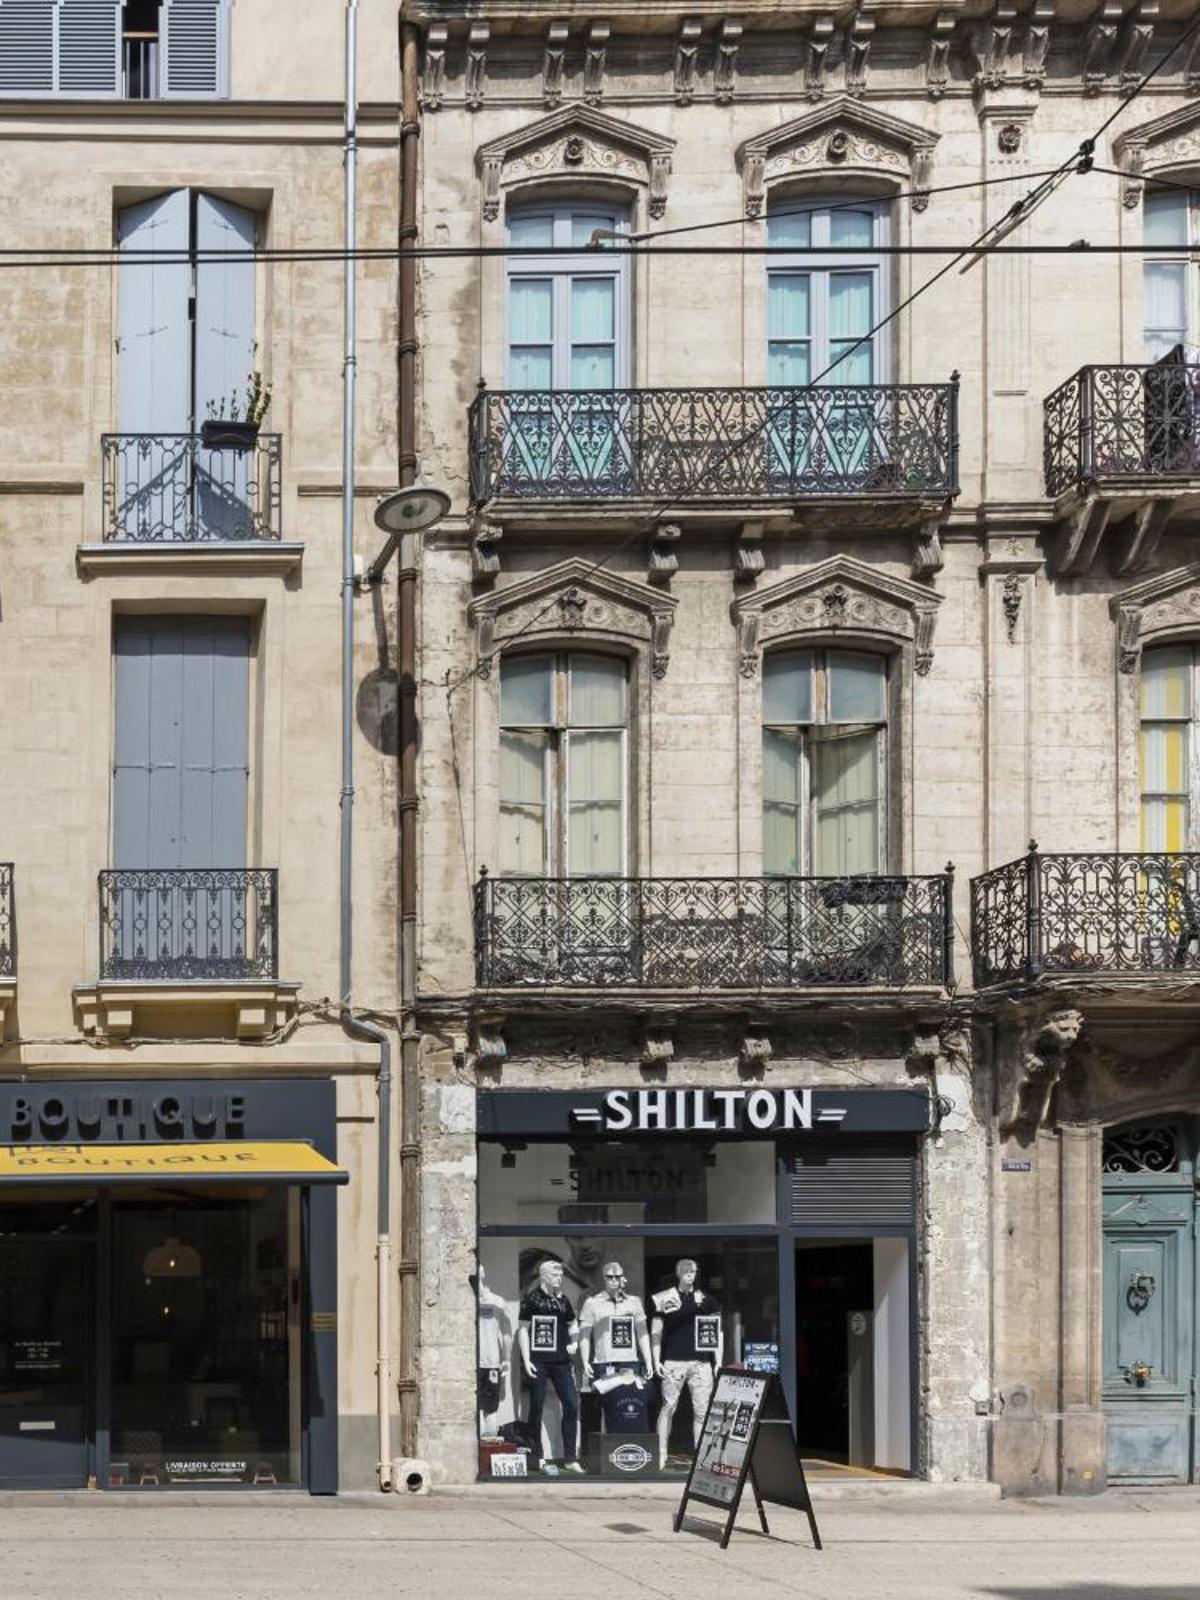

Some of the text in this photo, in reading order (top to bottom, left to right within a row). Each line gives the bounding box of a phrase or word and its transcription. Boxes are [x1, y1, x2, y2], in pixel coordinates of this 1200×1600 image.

[11, 1095, 245, 1139] BOUTIQUE
[606, 1088, 813, 1130] SHILTON
[17, 1152, 259, 1167] BOUTIQUE
[569, 1168, 683, 1192] SHILTON
